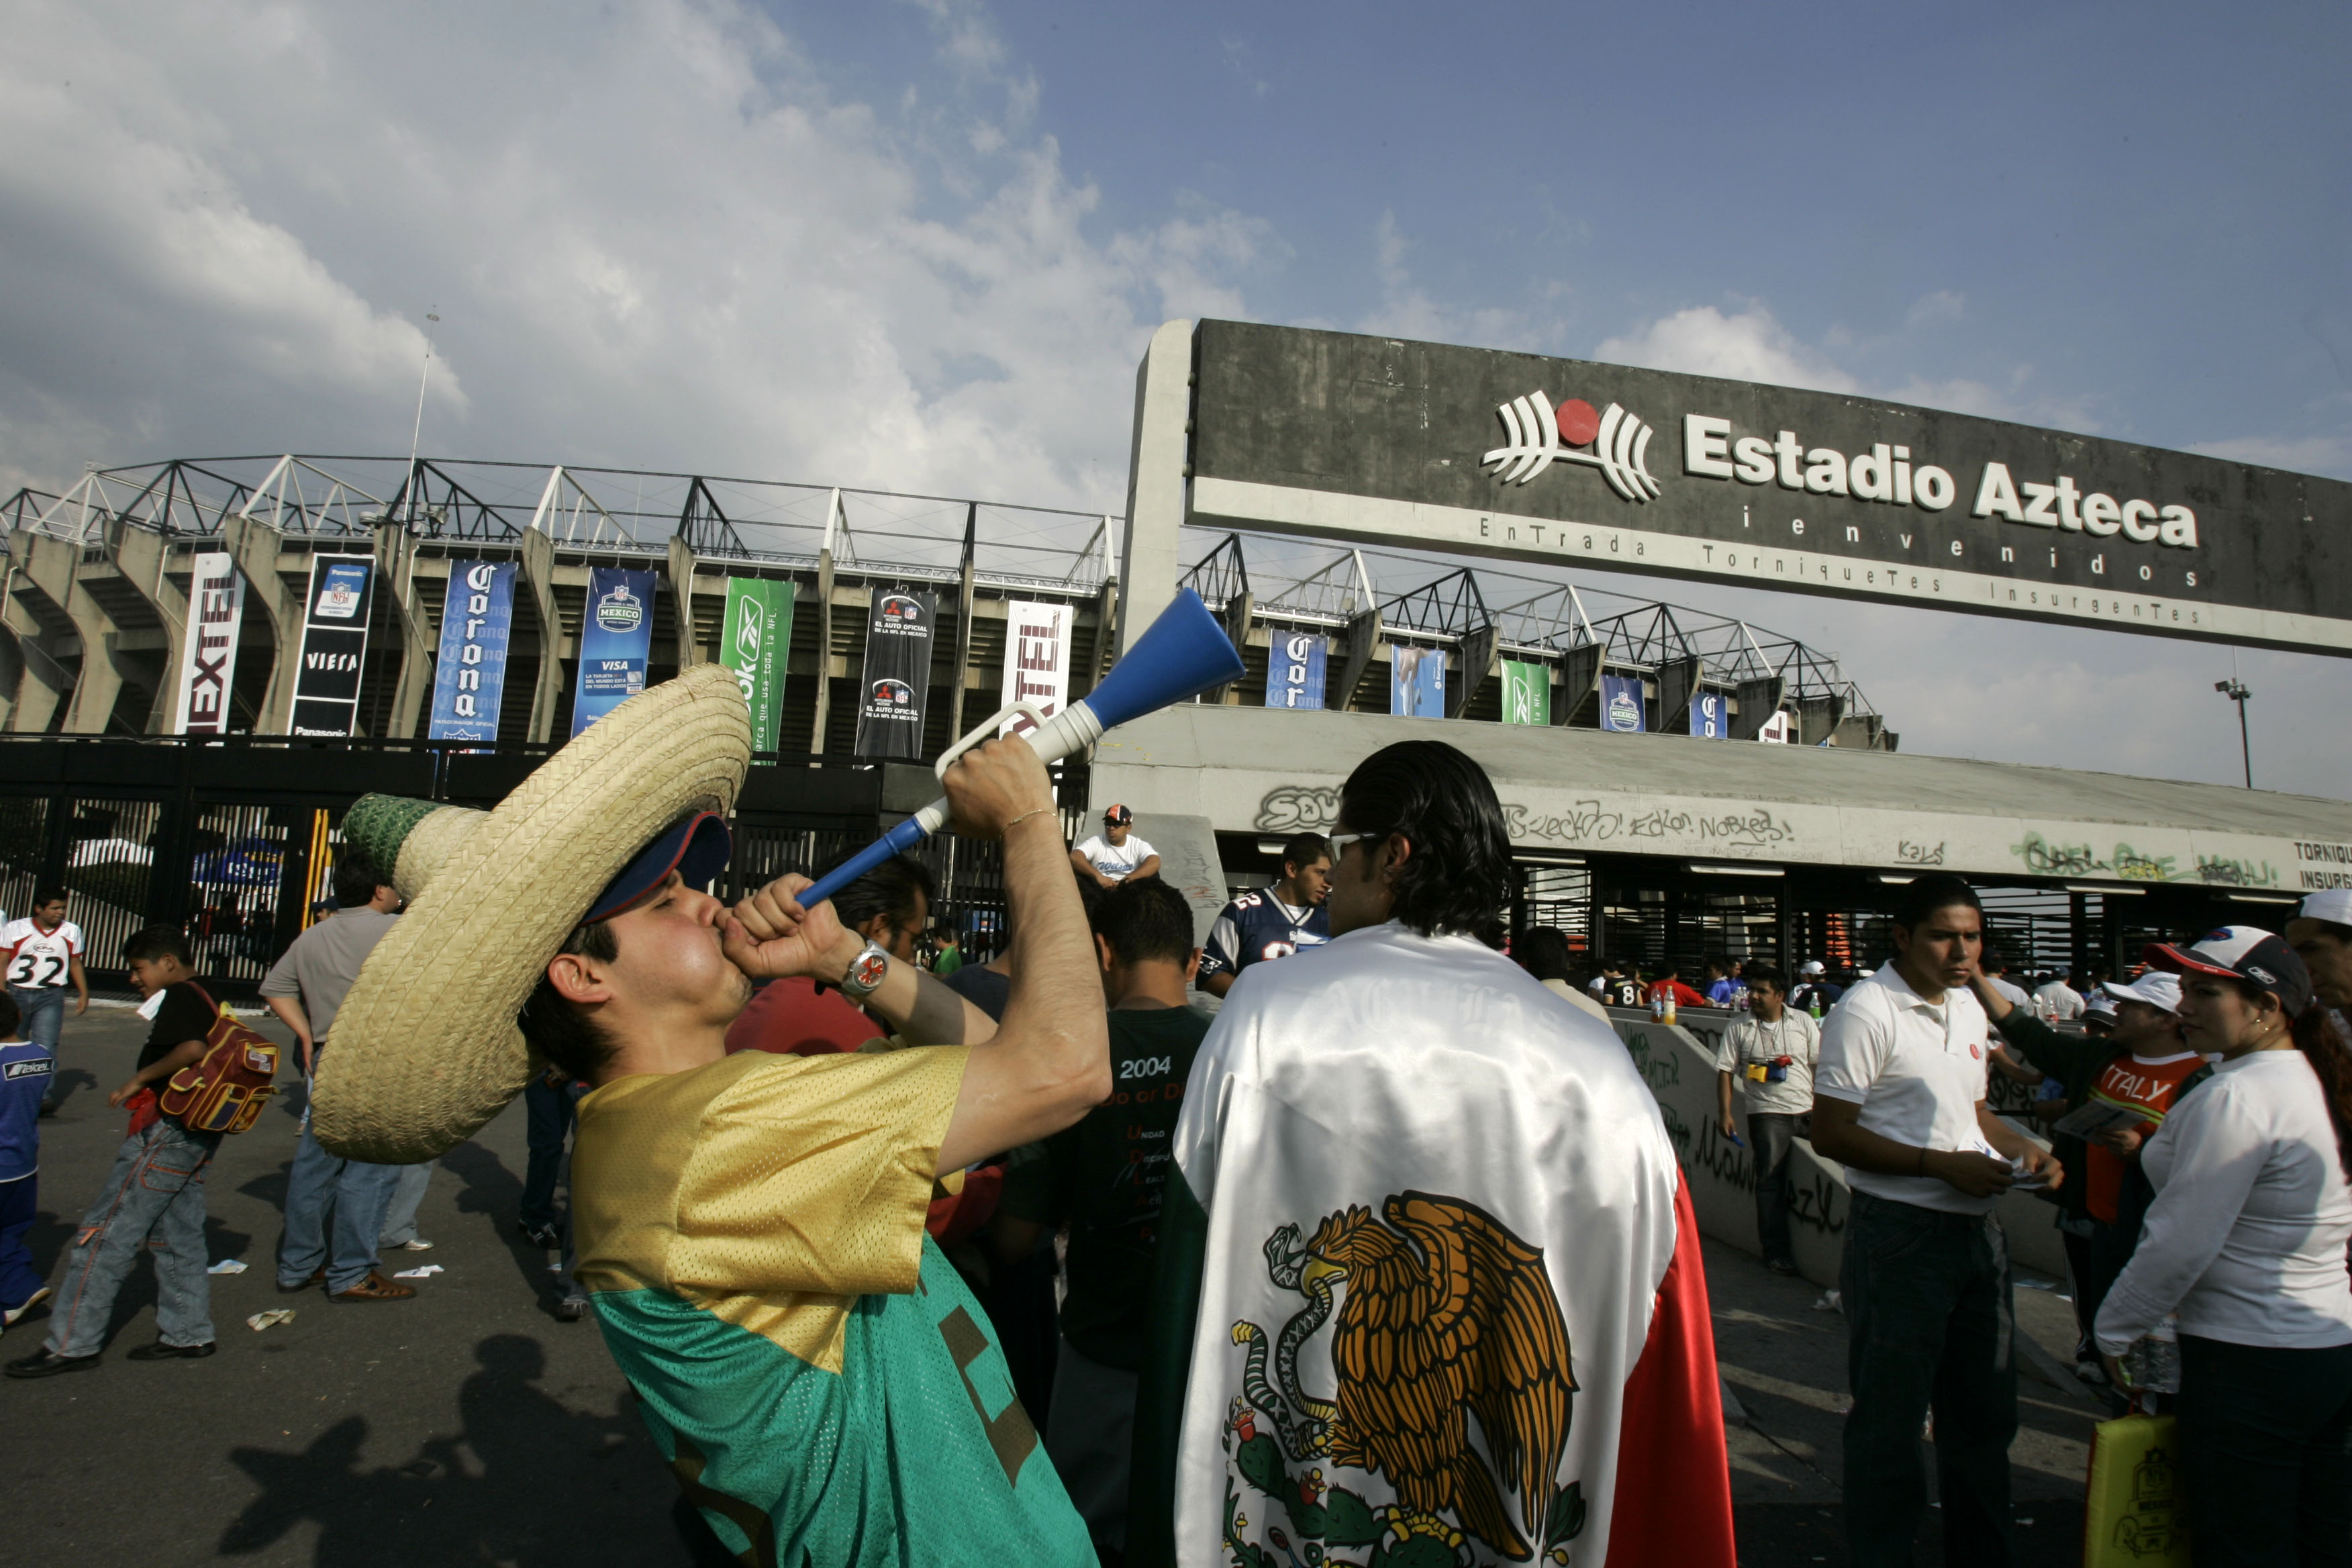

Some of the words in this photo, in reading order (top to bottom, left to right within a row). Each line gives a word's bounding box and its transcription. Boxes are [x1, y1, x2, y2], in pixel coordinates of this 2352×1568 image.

[1683, 413, 1955, 510] Estadio
[1972, 461, 2199, 548] Azteca
[332, 569, 362, 577] Panasonic
[600, 609, 638, 619] MEXICO
[883, 622, 902, 630] AUTO
[903, 624, 928, 632] OFICIAL
[187, 568, 235, 734] EXTEL
[454, 564, 497, 718] Corona
[601, 660, 628, 671] VISA
[764, 652, 773, 674] toda
[759, 703, 767, 721] que
[894, 707, 918, 716] OFICAL
[1612, 710, 1637, 720] MEXICO
[295, 726, 347, 737] Panasonic
[756, 727, 765, 752] arca
[2299, 870, 2352, 890] INSURG
[9, 954, 65, 988] 32
[1622, 985, 1634, 1005] 8
[1119, 1056, 1171, 1079] 2004
[2100, 1063, 2172, 1102] ITALY
[1134, 1087, 1159, 1104] or
[1164, 1082, 1185, 1100] Di
